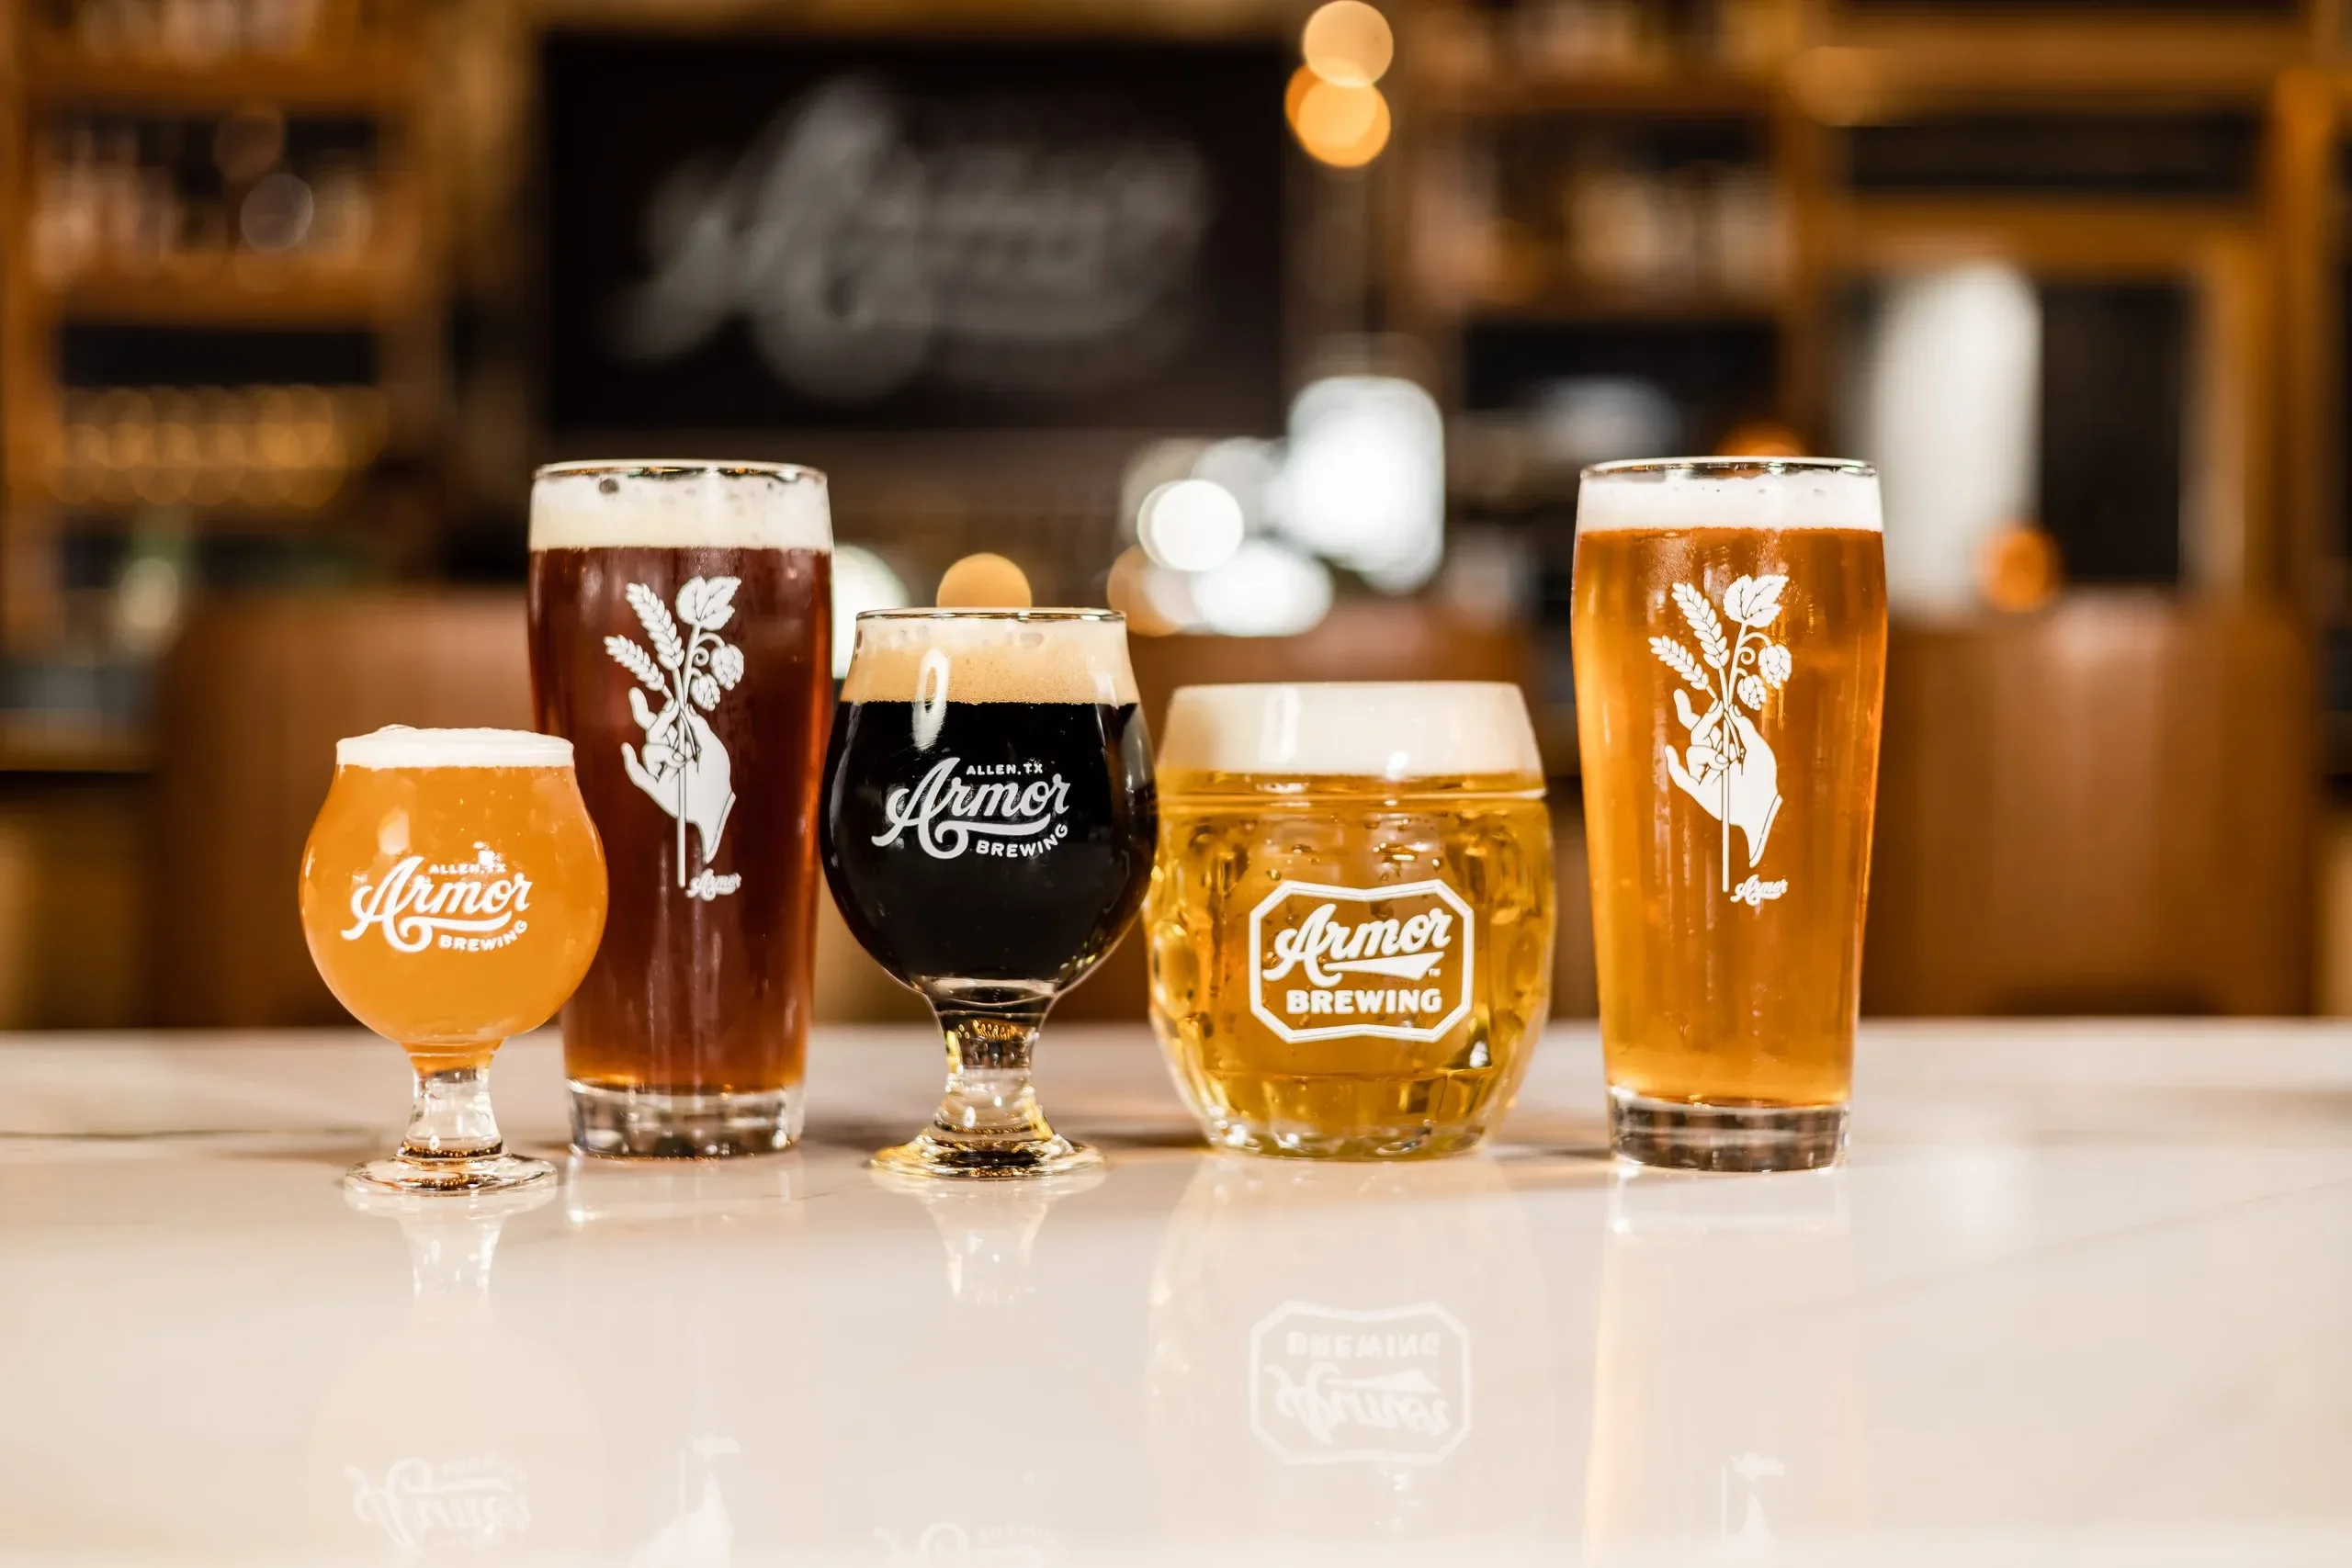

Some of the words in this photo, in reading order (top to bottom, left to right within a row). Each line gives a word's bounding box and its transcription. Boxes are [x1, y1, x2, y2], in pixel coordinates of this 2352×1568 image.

[871, 757, 1071, 859] Armor
[976, 823, 1069, 858] BREWING
[341, 855, 533, 953] Armor
[437, 919, 528, 952] BREWING
[1261, 903, 1453, 988] Armor
[1286, 987, 1442, 1014] BREWING
